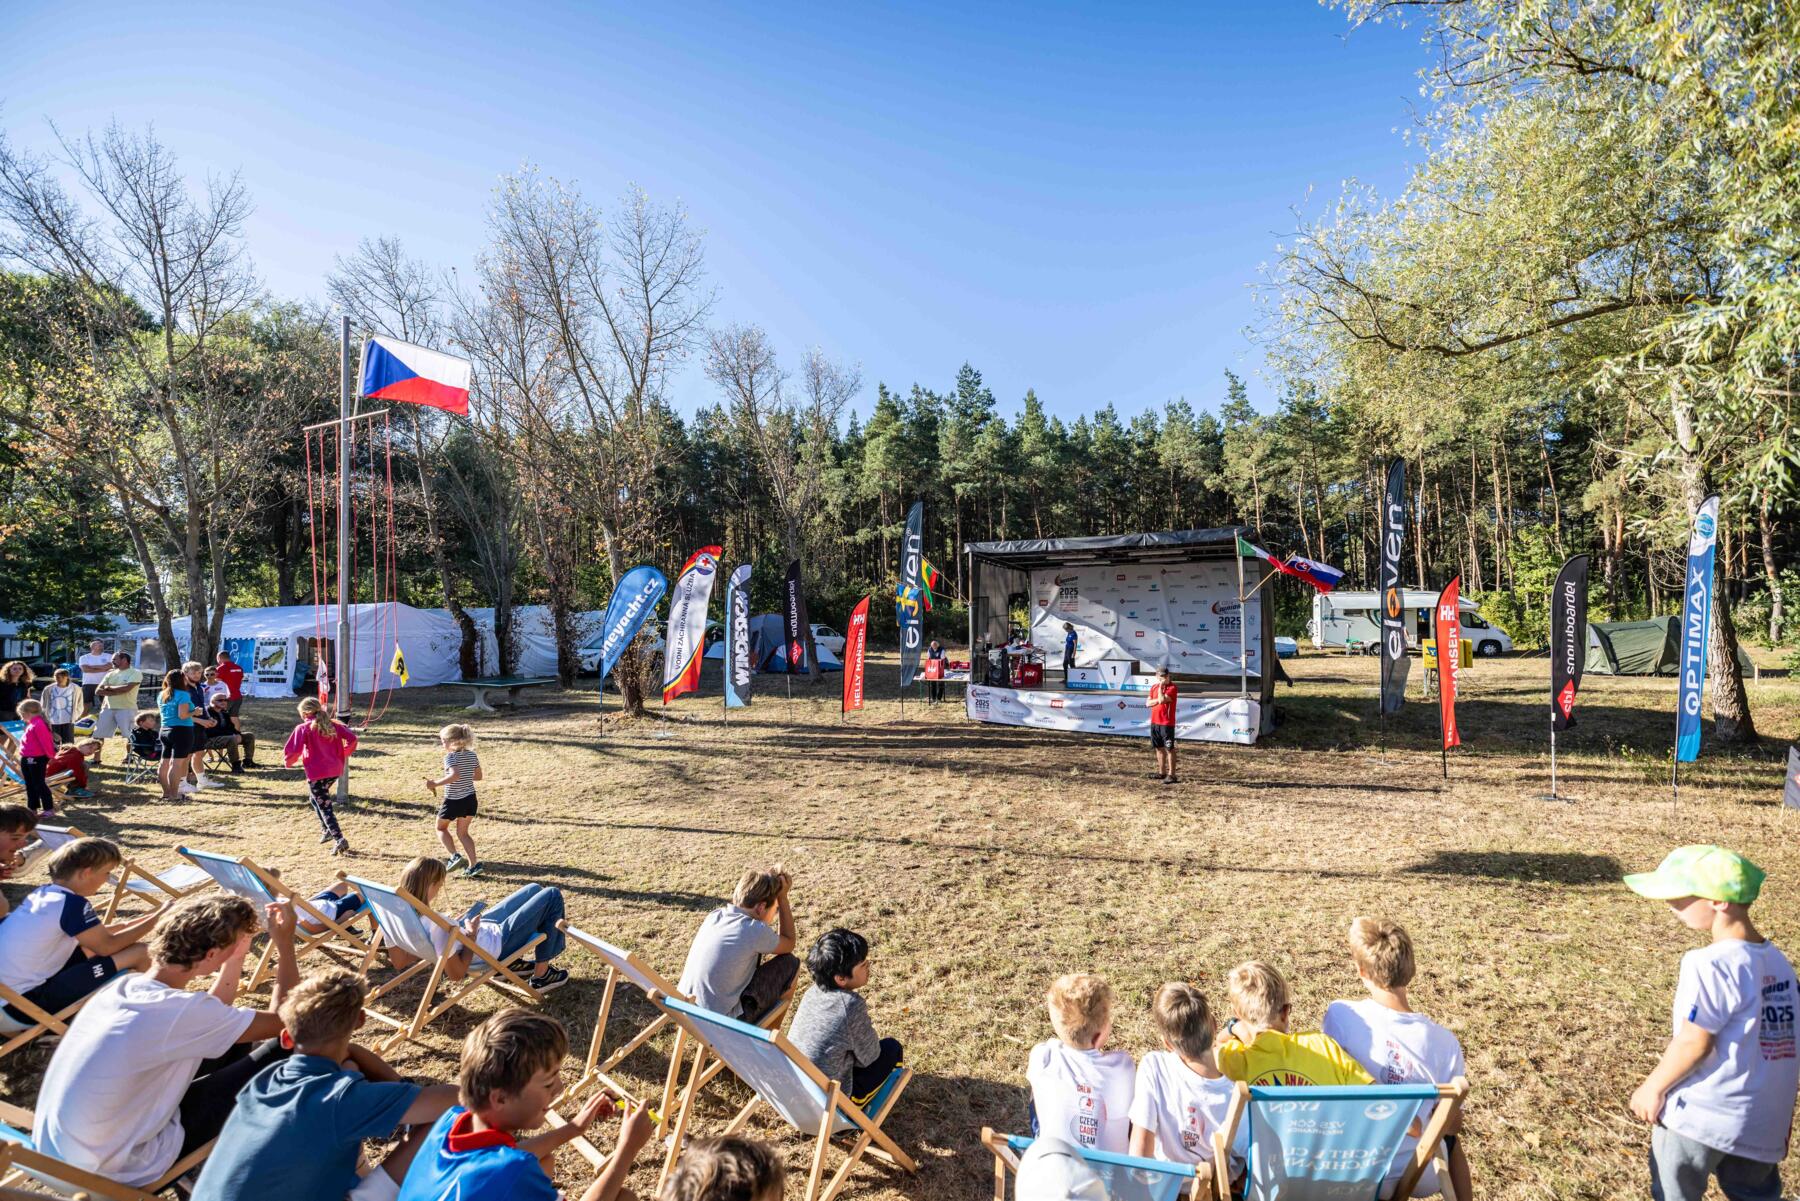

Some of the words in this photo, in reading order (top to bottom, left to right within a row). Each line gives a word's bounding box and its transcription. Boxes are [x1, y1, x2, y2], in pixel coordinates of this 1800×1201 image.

[1219, 617, 1242, 625] 2025
[856, 628, 864, 672] HANSEN
[1081, 672, 1086, 680] 2
[1112, 666, 1117, 676] 1
[1080, 1116, 1098, 1127] CZECH
[1080, 1125, 1097, 1136] CADET
[1080, 1135, 1096, 1145] TEAM
